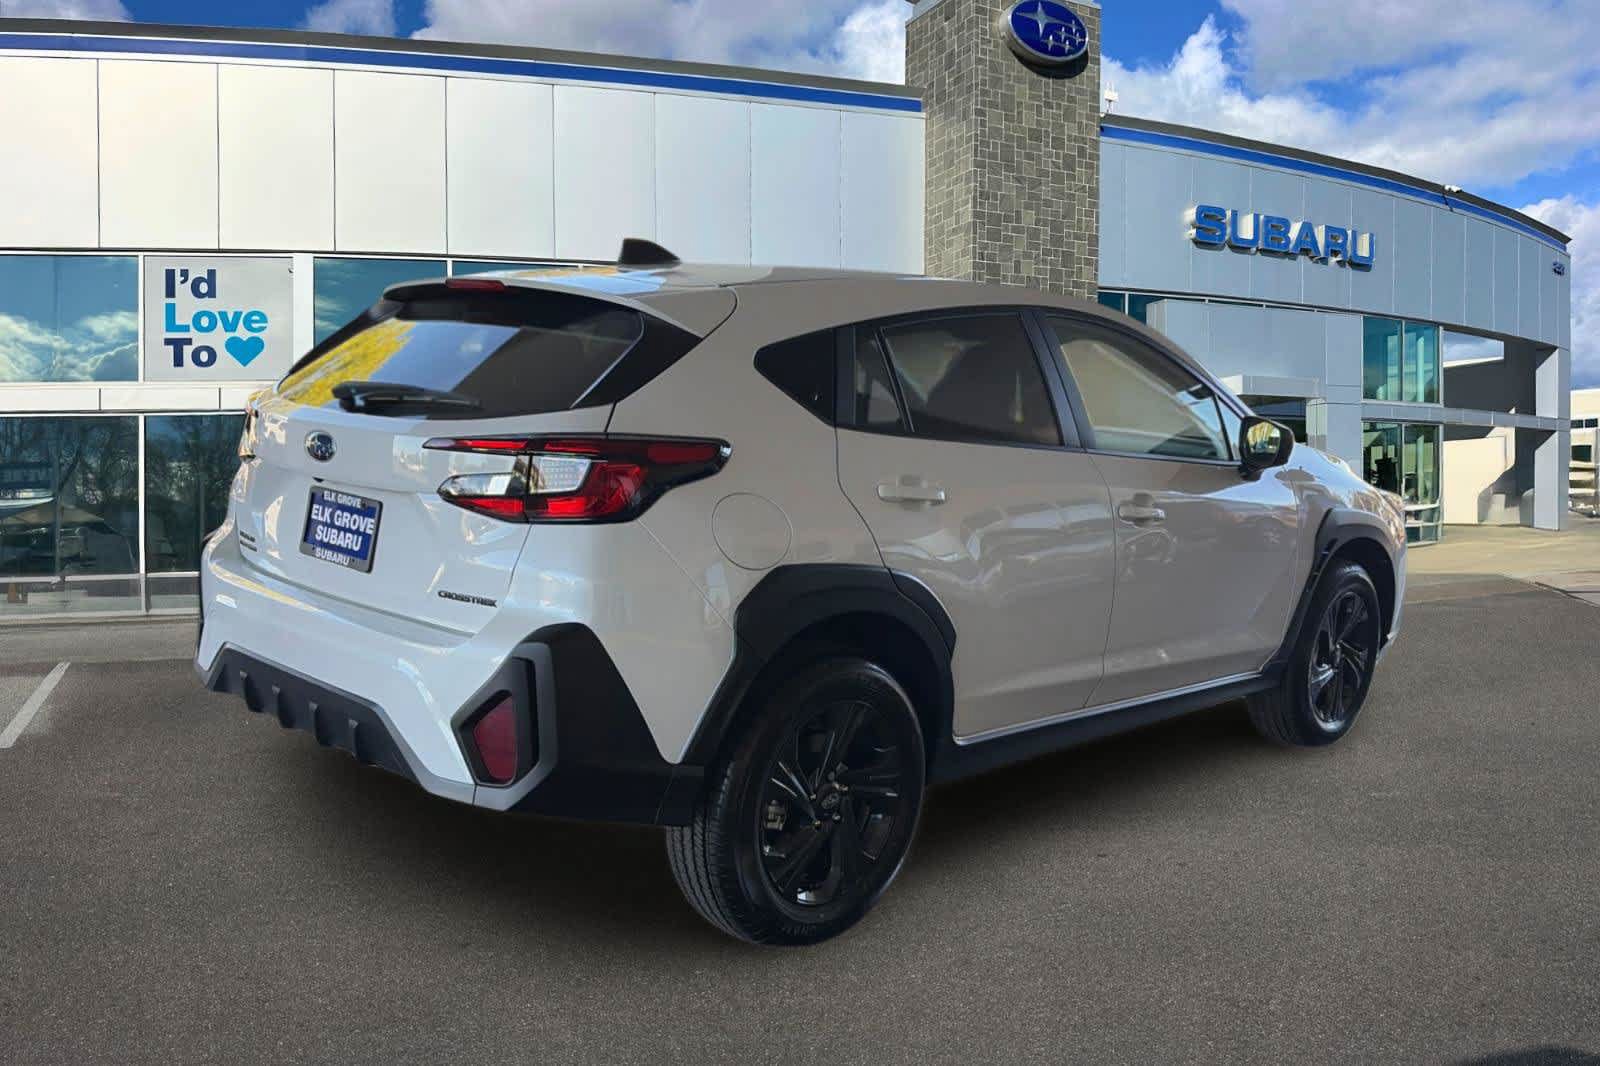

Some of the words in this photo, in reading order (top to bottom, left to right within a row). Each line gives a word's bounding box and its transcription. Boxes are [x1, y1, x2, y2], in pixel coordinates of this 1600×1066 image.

[1190, 204, 1376, 272] SUBARU
[165, 303, 268, 333] Love
[164, 338, 217, 368] To
[323, 491, 338, 503] ELK
[337, 494, 362, 508] GROVE
[311, 504, 333, 523] ELK
[333, 510, 375, 535] GROVE
[315, 525, 362, 551] SUBARU
[315, 548, 350, 566] SUBARU
